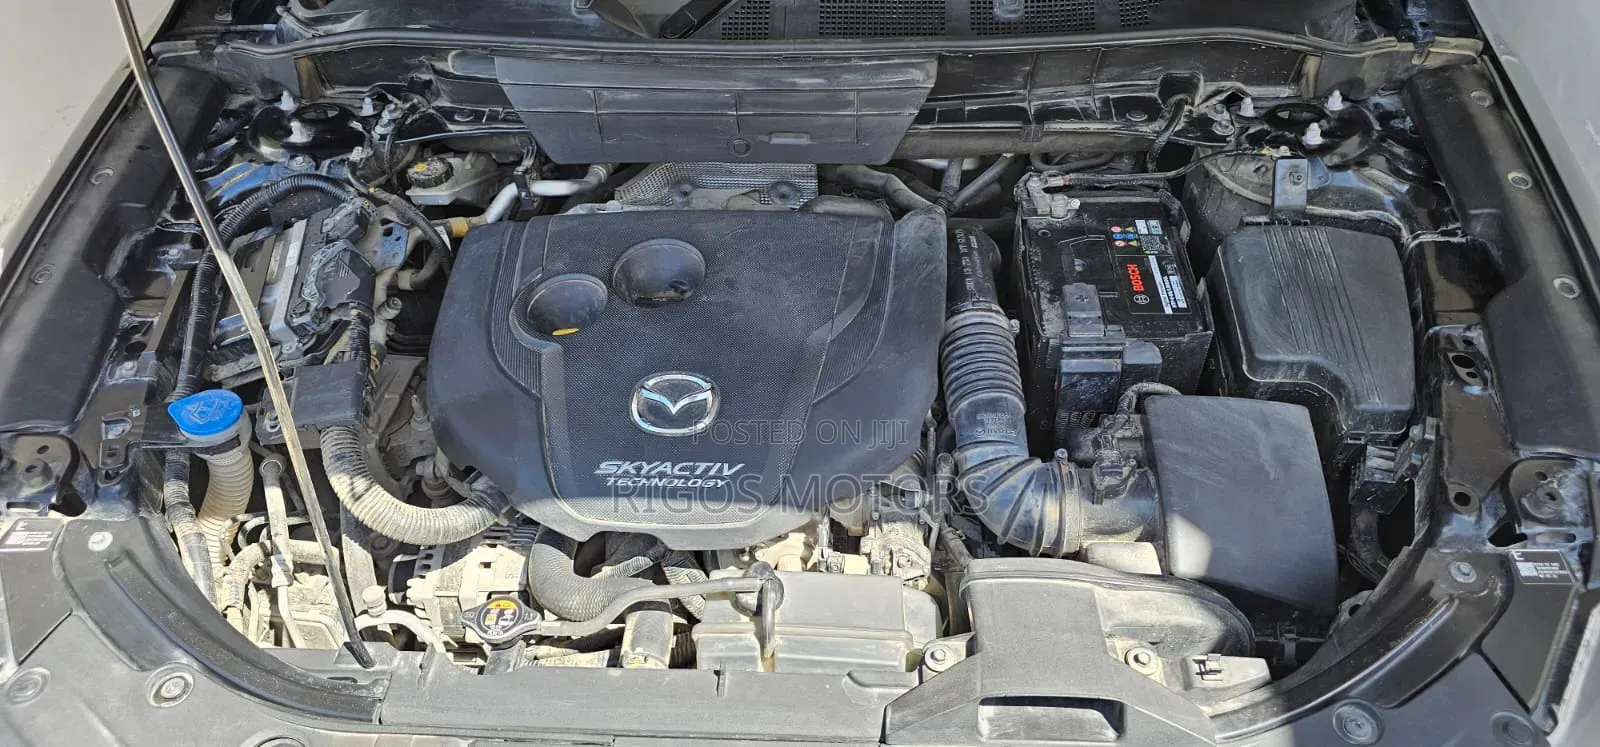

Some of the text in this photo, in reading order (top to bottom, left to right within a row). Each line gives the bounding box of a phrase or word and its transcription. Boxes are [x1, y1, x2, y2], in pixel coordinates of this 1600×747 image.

[1127, 264, 1144, 292] BOSCH
[594, 461, 745, 476] SKYACTIV
[606, 477, 730, 488] TECHNOLOGY
